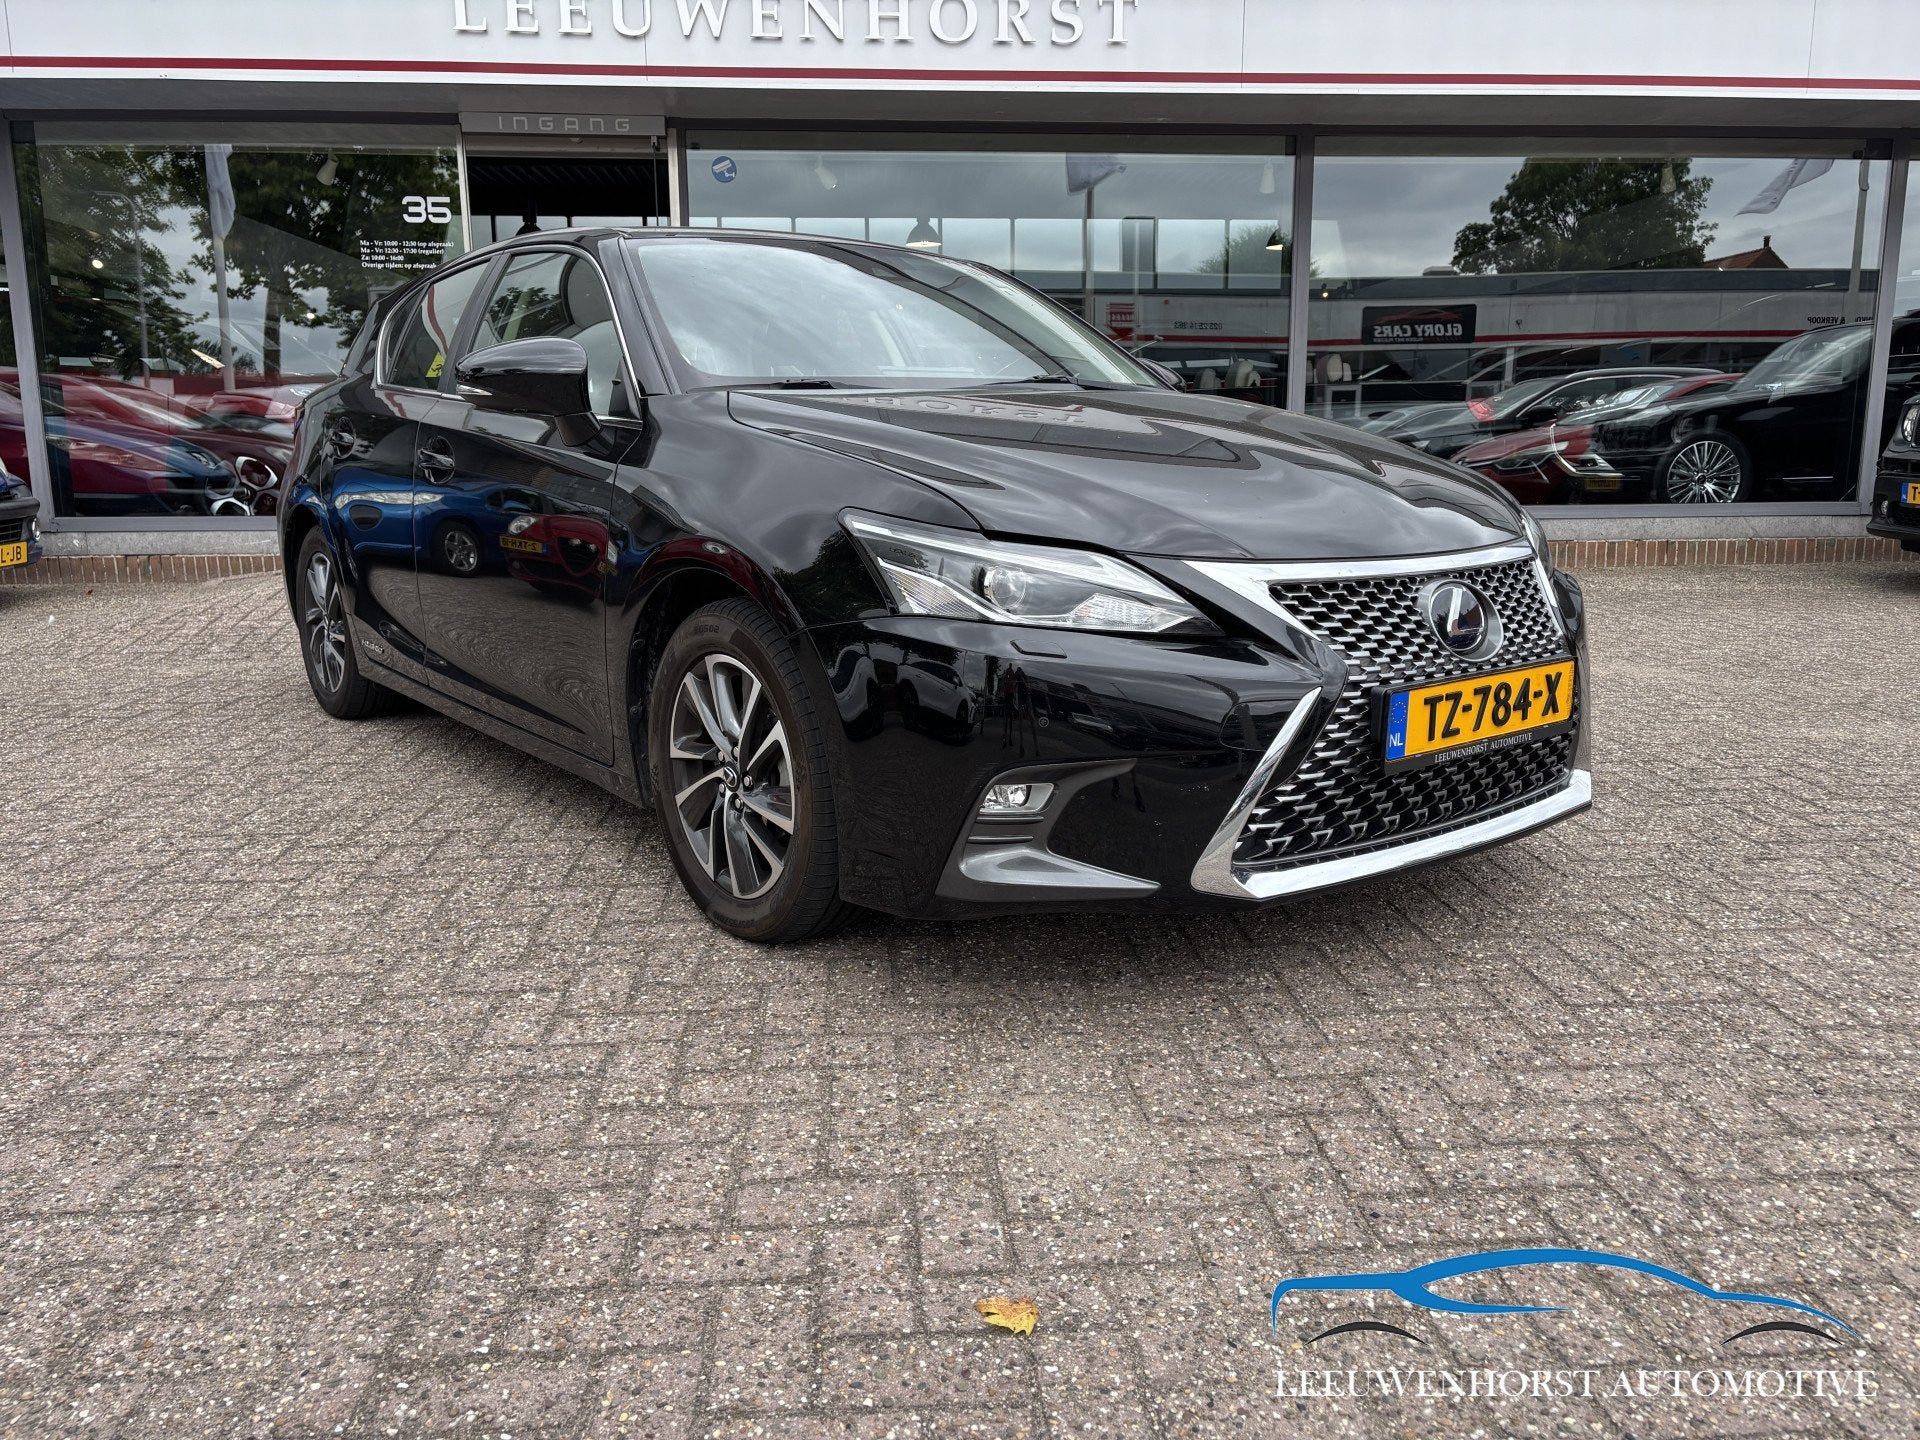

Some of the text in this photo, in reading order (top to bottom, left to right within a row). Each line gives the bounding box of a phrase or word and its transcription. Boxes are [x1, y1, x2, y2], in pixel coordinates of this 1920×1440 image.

[453, 0, 1138, 44] LEEUWENHORST
[499, 115, 630, 132] INGANG
[402, 195, 452, 224] 35
[361, 261, 384, 269] Overige
[1423, 671, 1563, 742] TZ-784-X
[1389, 732, 1403, 748] NL
[1434, 732, 1533, 763] LEEUWENHORST AUTOMOTIVE
